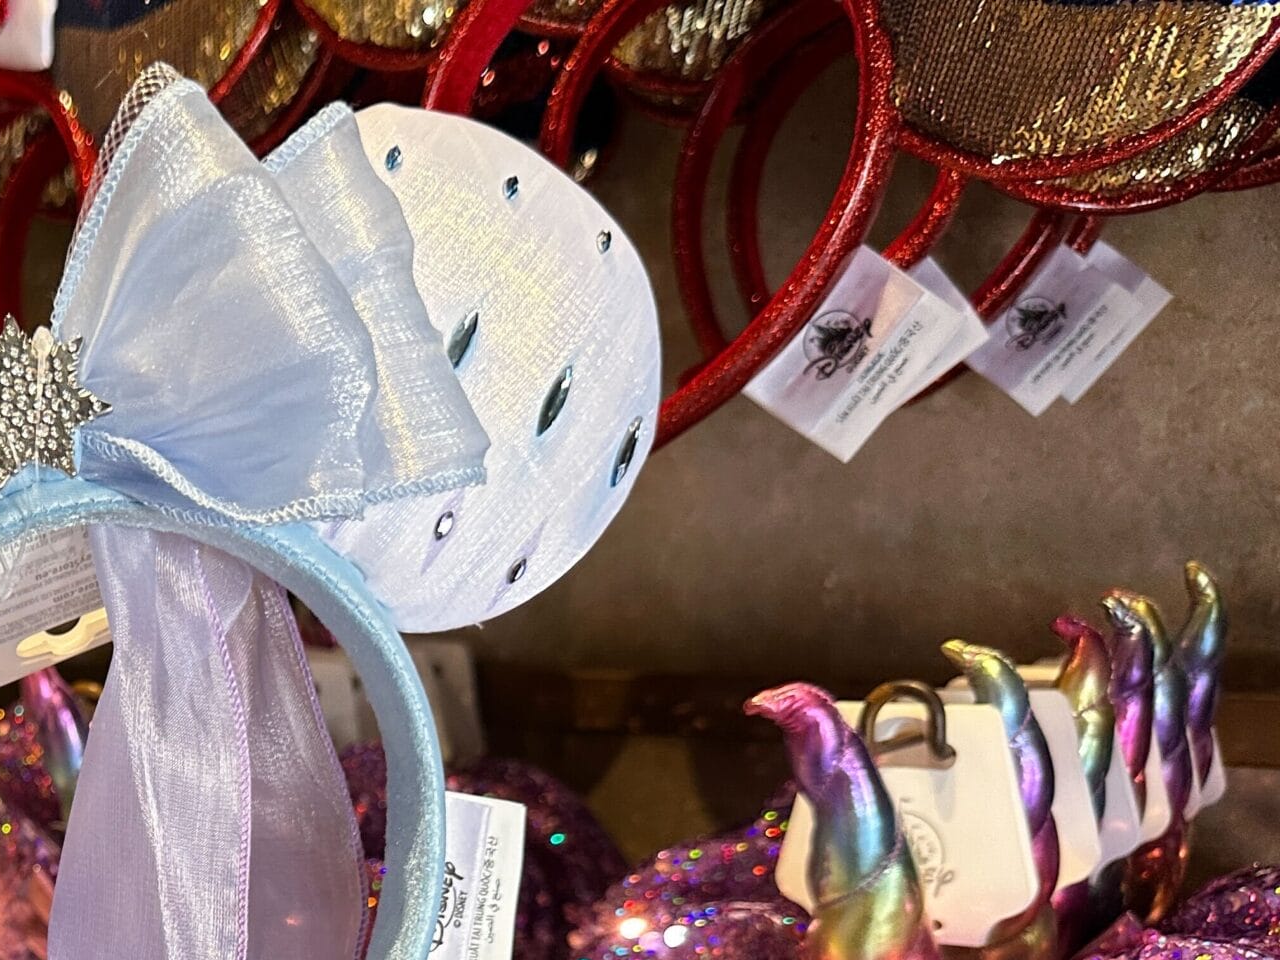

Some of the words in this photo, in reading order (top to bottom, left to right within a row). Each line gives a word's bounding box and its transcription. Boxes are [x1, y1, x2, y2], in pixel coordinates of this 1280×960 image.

[802, 316, 873, 381] Disney
[454, 890, 468, 918] DISNEY
[473, 897, 487, 926] TRUNG
